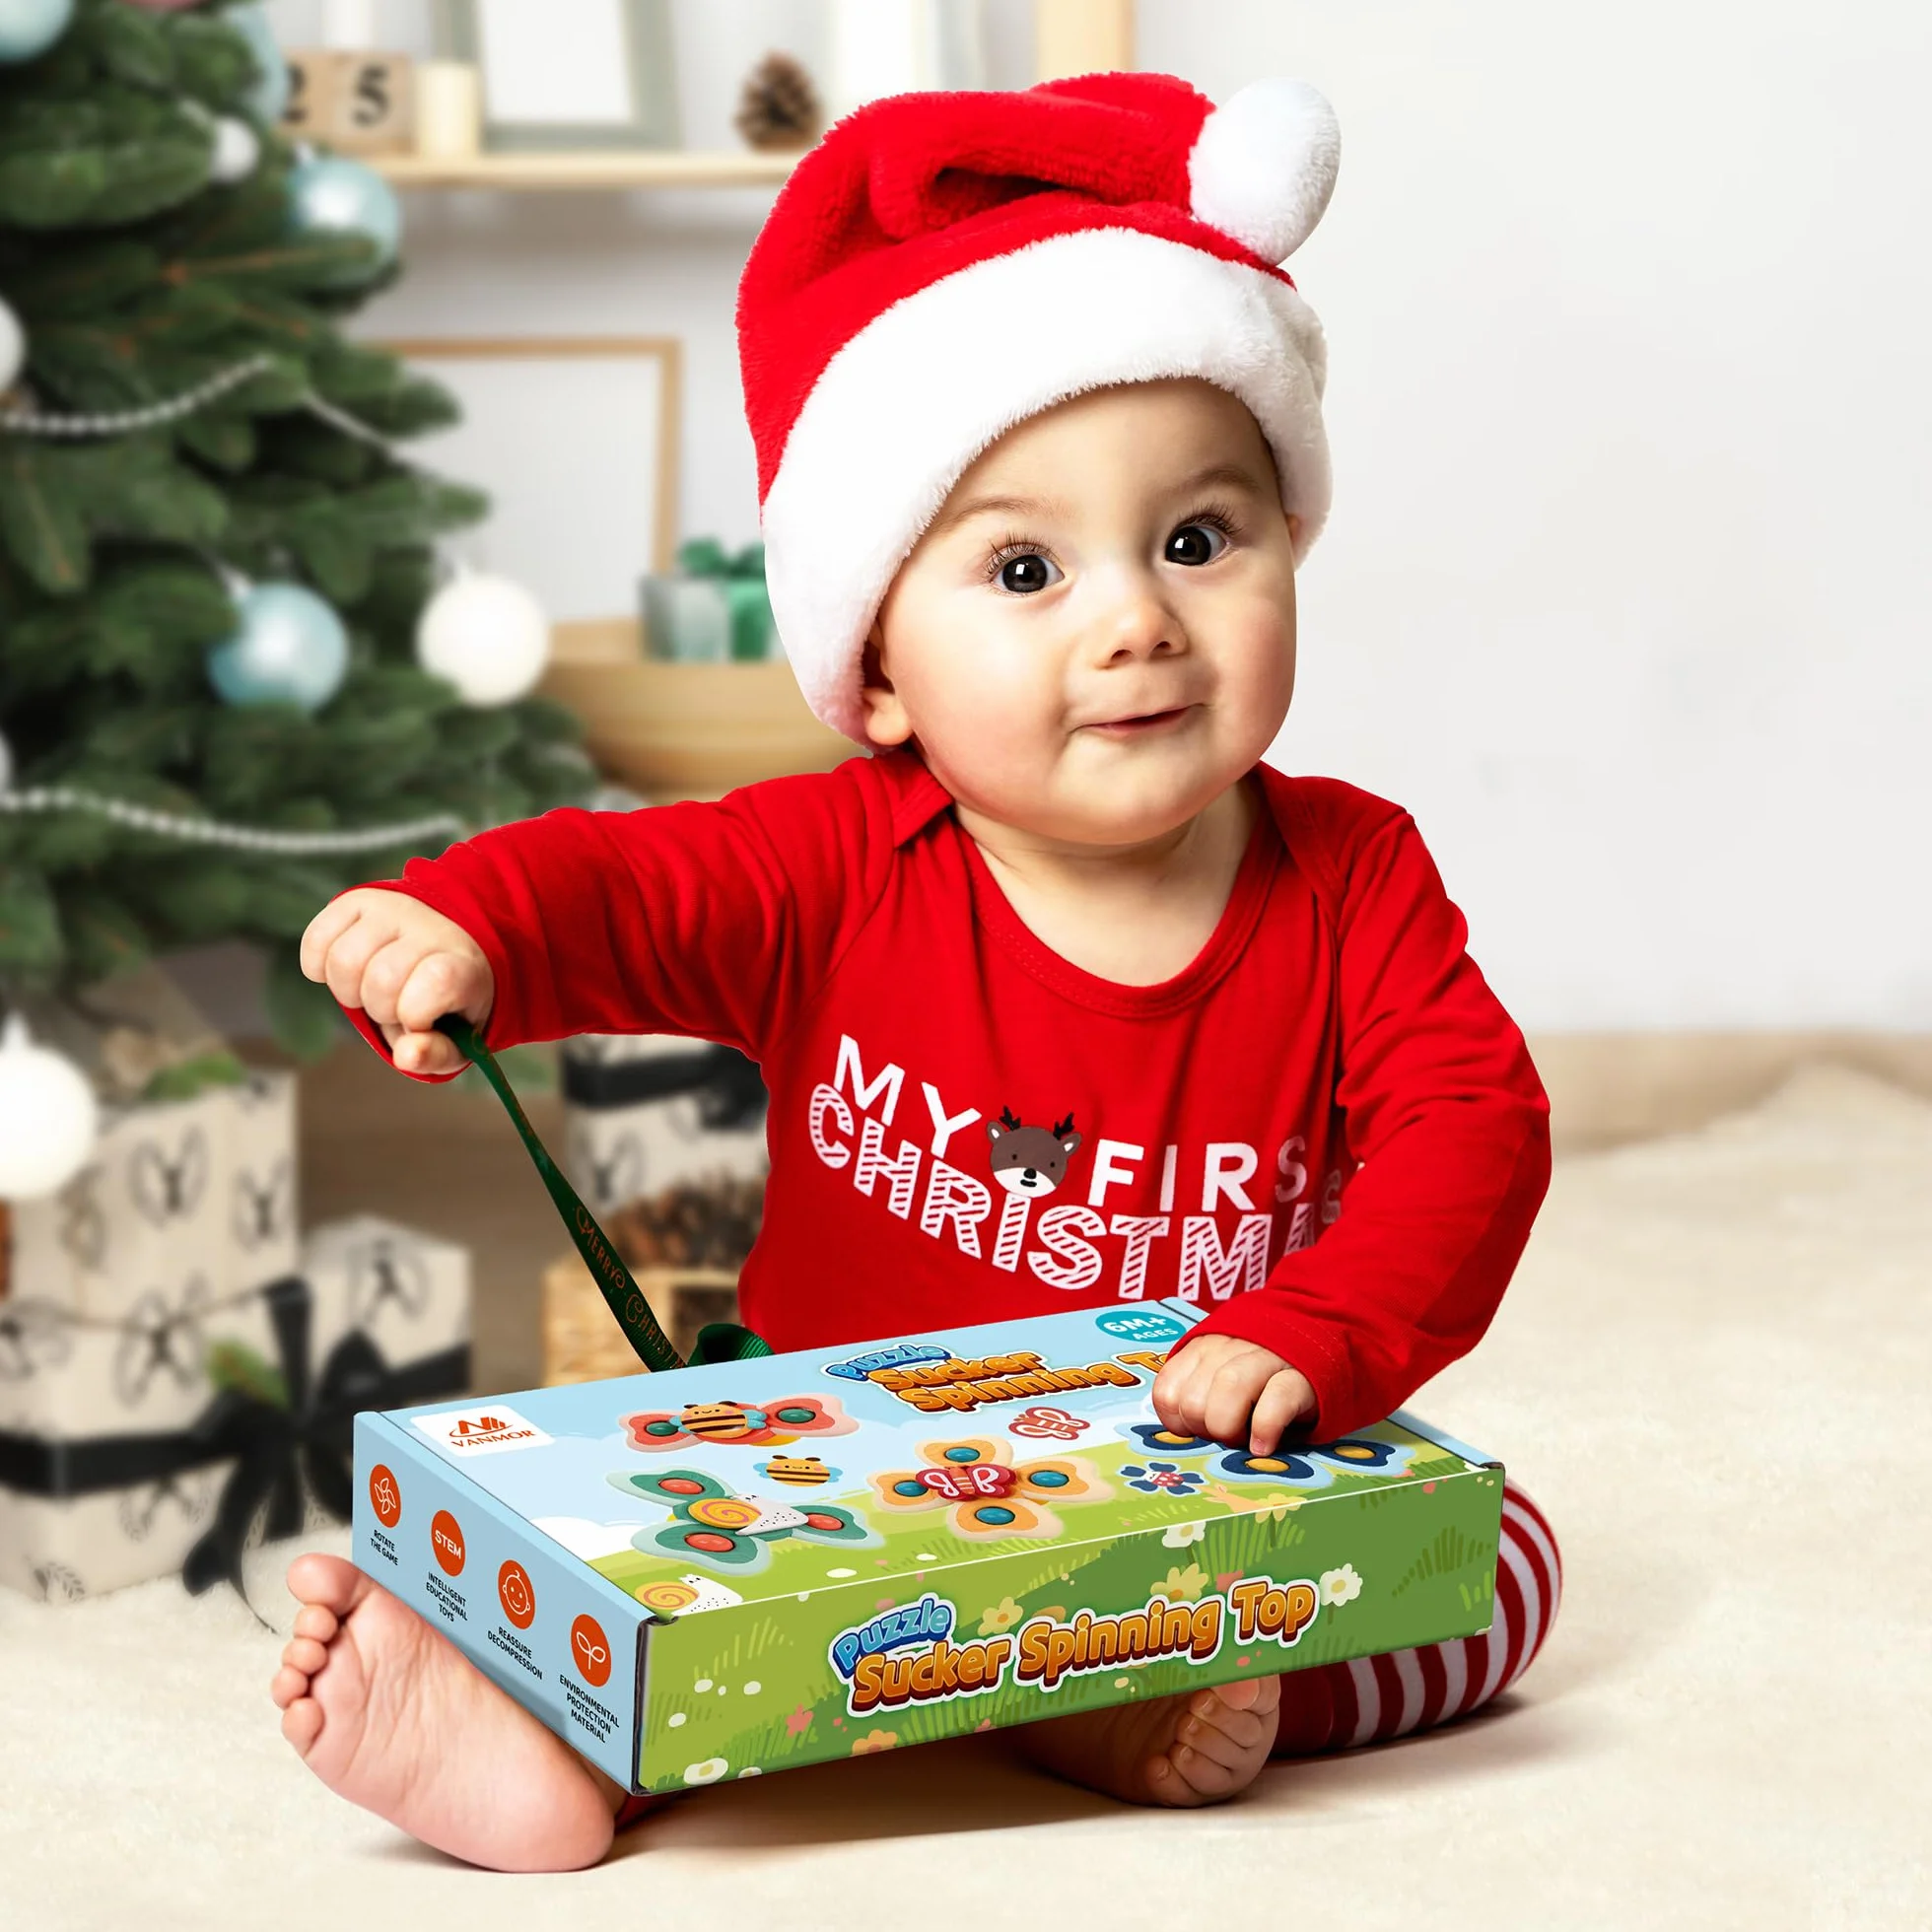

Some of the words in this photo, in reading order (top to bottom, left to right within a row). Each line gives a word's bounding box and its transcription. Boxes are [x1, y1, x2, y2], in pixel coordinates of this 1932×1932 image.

[834, 1034, 982, 1157] MY
[1087, 1136, 1308, 1212] FIRS
[1103, 1316, 1167, 1333] 6M+
[1132, 1327, 1180, 1341] AGES
[826, 1345, 951, 1380] Puzzle
[867, 1351, 1043, 1392] Sucker
[896, 1361, 1141, 1413] Spinning
[450, 1429, 536, 1448] VANMOR
[370, 1538, 381, 1552] THE
[381, 1548, 399, 1566] GAME
[374, 1529, 395, 1552] ROTATE
[435, 1529, 462, 1560] STEM
[426, 1581, 468, 1622] EDUCATIONAL
[428, 1571, 466, 1608] INTELLIGENT
[439, 1603, 454, 1622] TOYS
[487, 1630, 543, 1681] DECOMPRESSION
[498, 1626, 532, 1660] REASSURE
[832, 1598, 954, 1679] Puzzle
[852, 1636, 1011, 1710] Sucker
[1018, 1596, 1223, 1680] Spinning
[1230, 1580, 1318, 1645] Top
[559, 1674, 620, 1728] ENVIRONMENTAL
[566, 1692, 611, 1735] PROTECTION
[571, 1709, 606, 1744] MATERIAL
